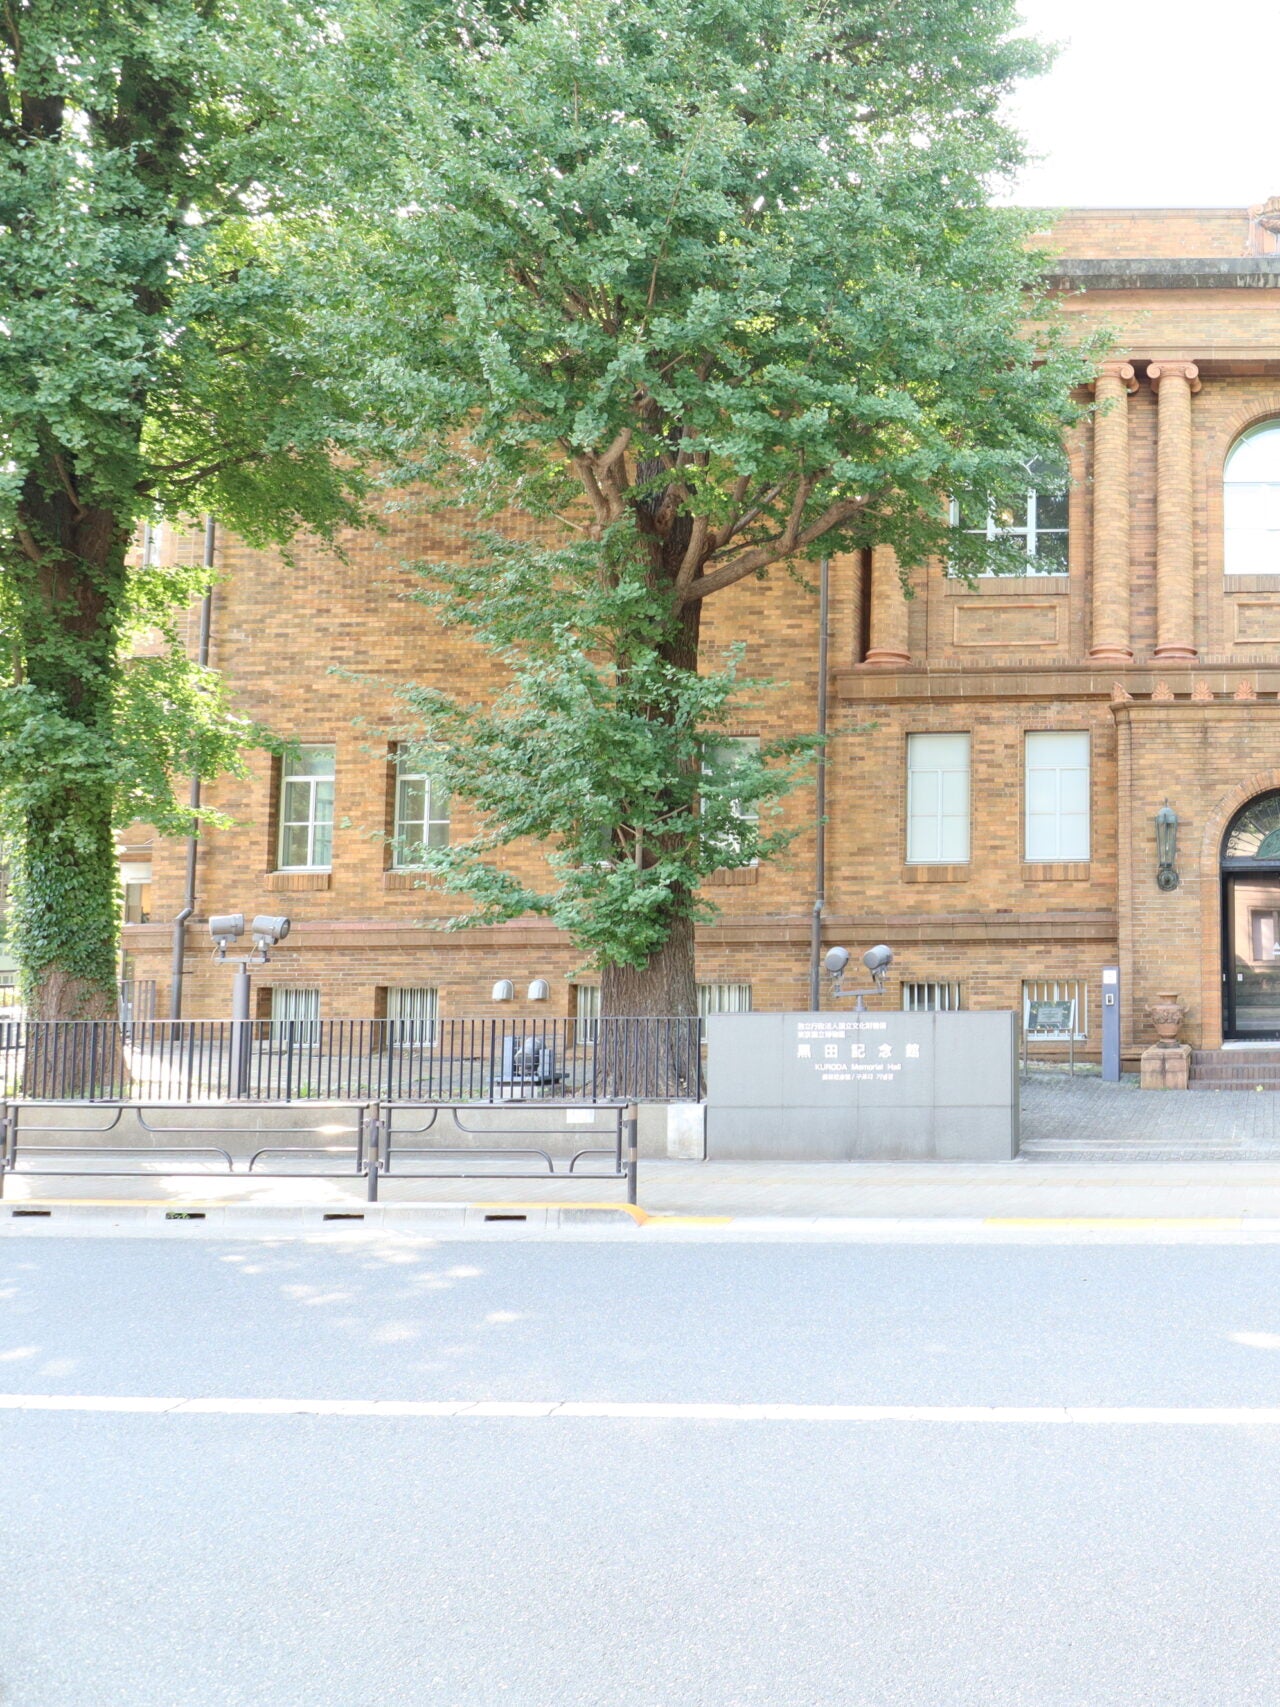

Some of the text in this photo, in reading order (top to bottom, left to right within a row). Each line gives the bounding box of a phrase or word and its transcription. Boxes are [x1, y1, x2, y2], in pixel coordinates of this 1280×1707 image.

[798, 1022, 887, 1030] 立行人立文化財
